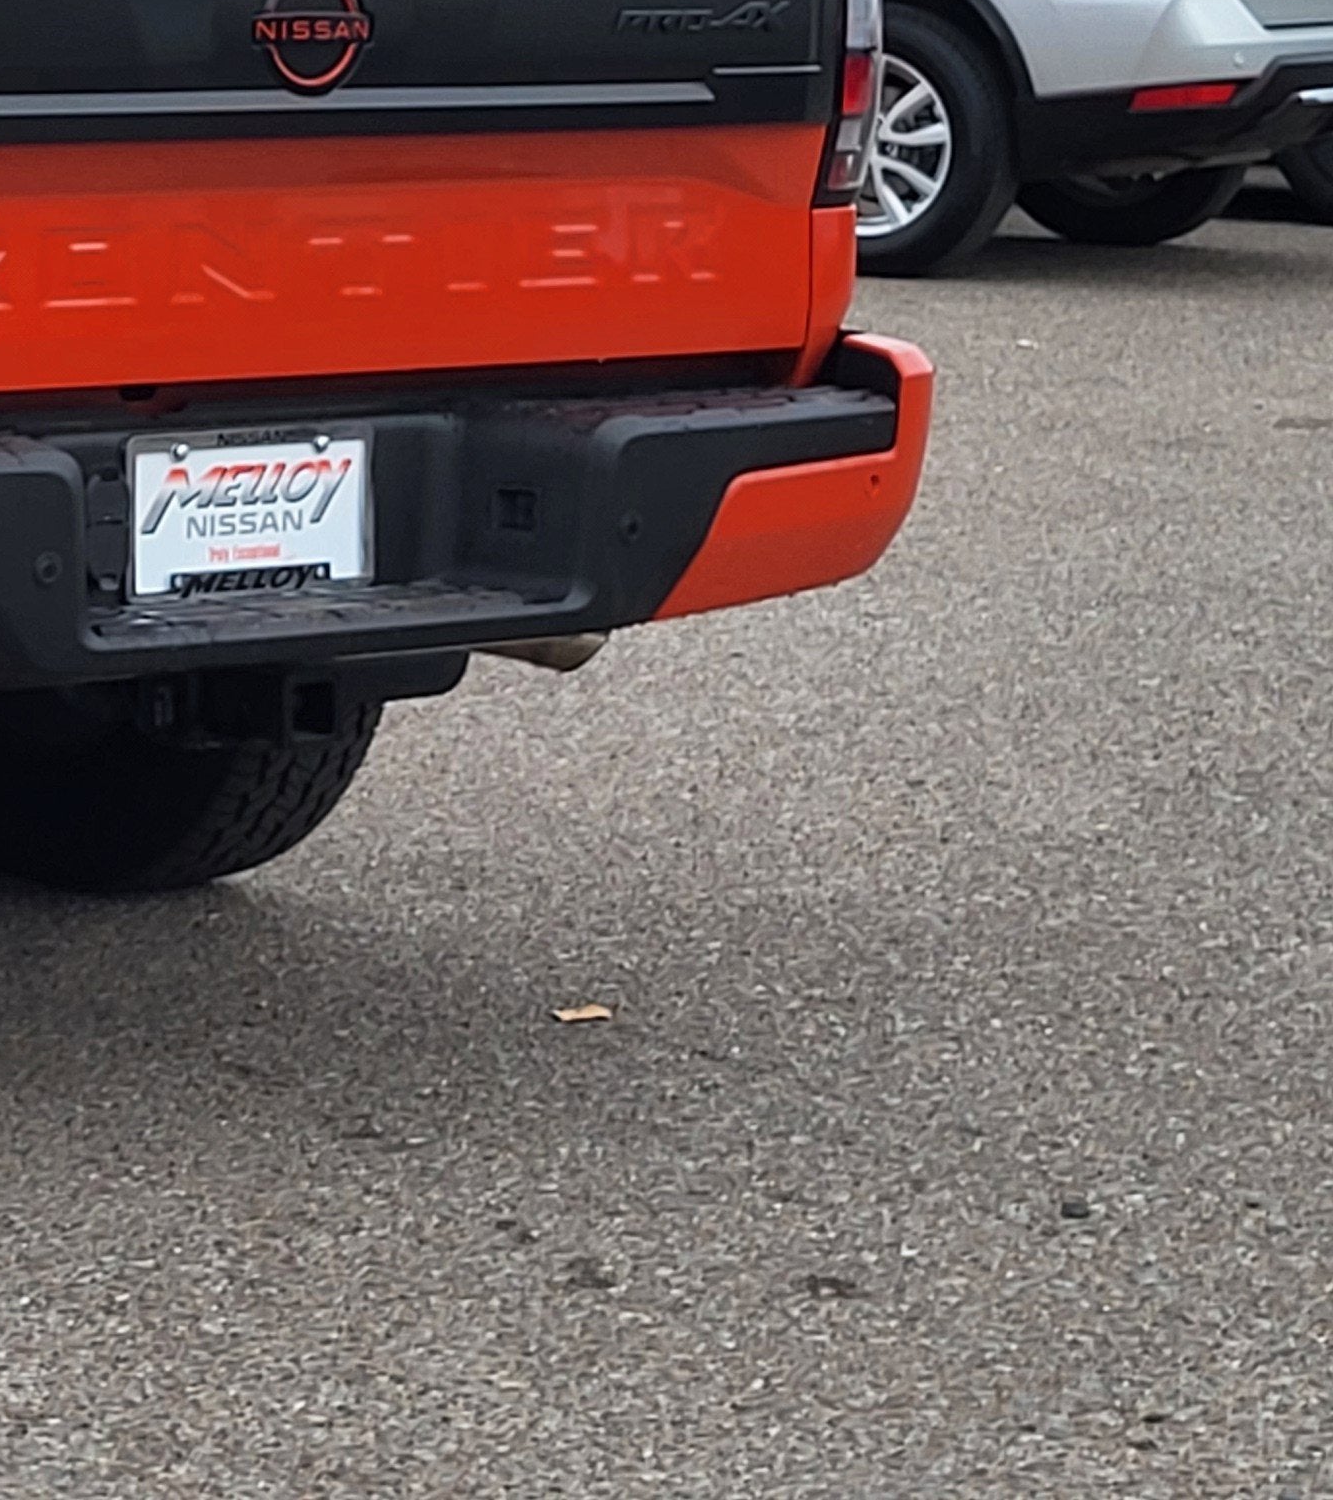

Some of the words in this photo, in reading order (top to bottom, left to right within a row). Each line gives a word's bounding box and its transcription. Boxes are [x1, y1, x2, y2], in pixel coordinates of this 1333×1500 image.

[254, 18, 371, 42] NISSAN
[140, 458, 353, 536] MELLOY
[186, 508, 304, 540] NISSAN
[181, 562, 312, 599] MELLOY
